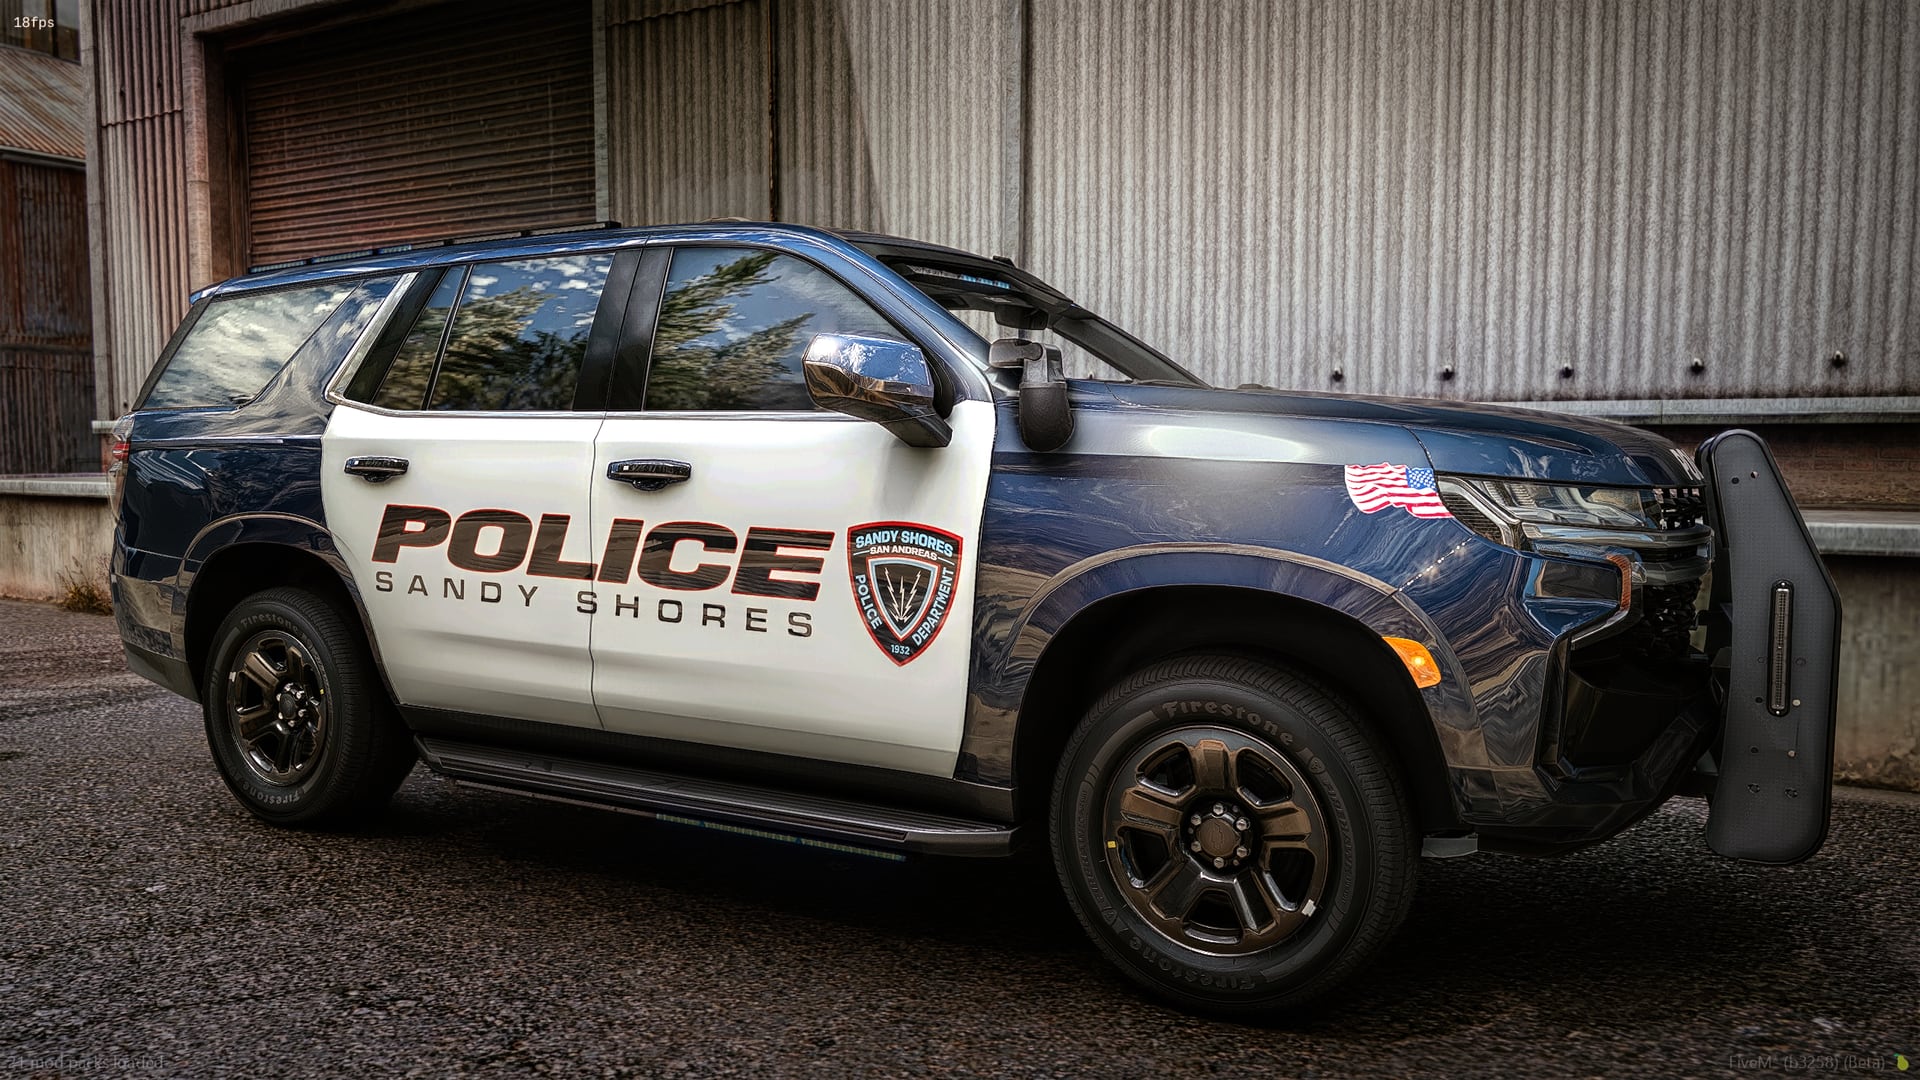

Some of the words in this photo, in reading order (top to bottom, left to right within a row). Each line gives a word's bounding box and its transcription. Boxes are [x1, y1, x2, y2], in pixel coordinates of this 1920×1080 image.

[371, 503, 836, 602] POLICE
[855, 530, 899, 549] SANDY
[901, 530, 954, 558] SHORES
[870, 545, 889, 555] SAN
[891, 545, 938, 561] ANDREAS
[240, 612, 299, 633] Firestone
[375, 571, 539, 607] SANDY
[576, 591, 813, 638] SHORES
[855, 574, 883, 630] POLICE
[911, 567, 954, 647] DEPARTMENT
[890, 644, 910, 656] 1932
[1162, 701, 1293, 746] Firestone
